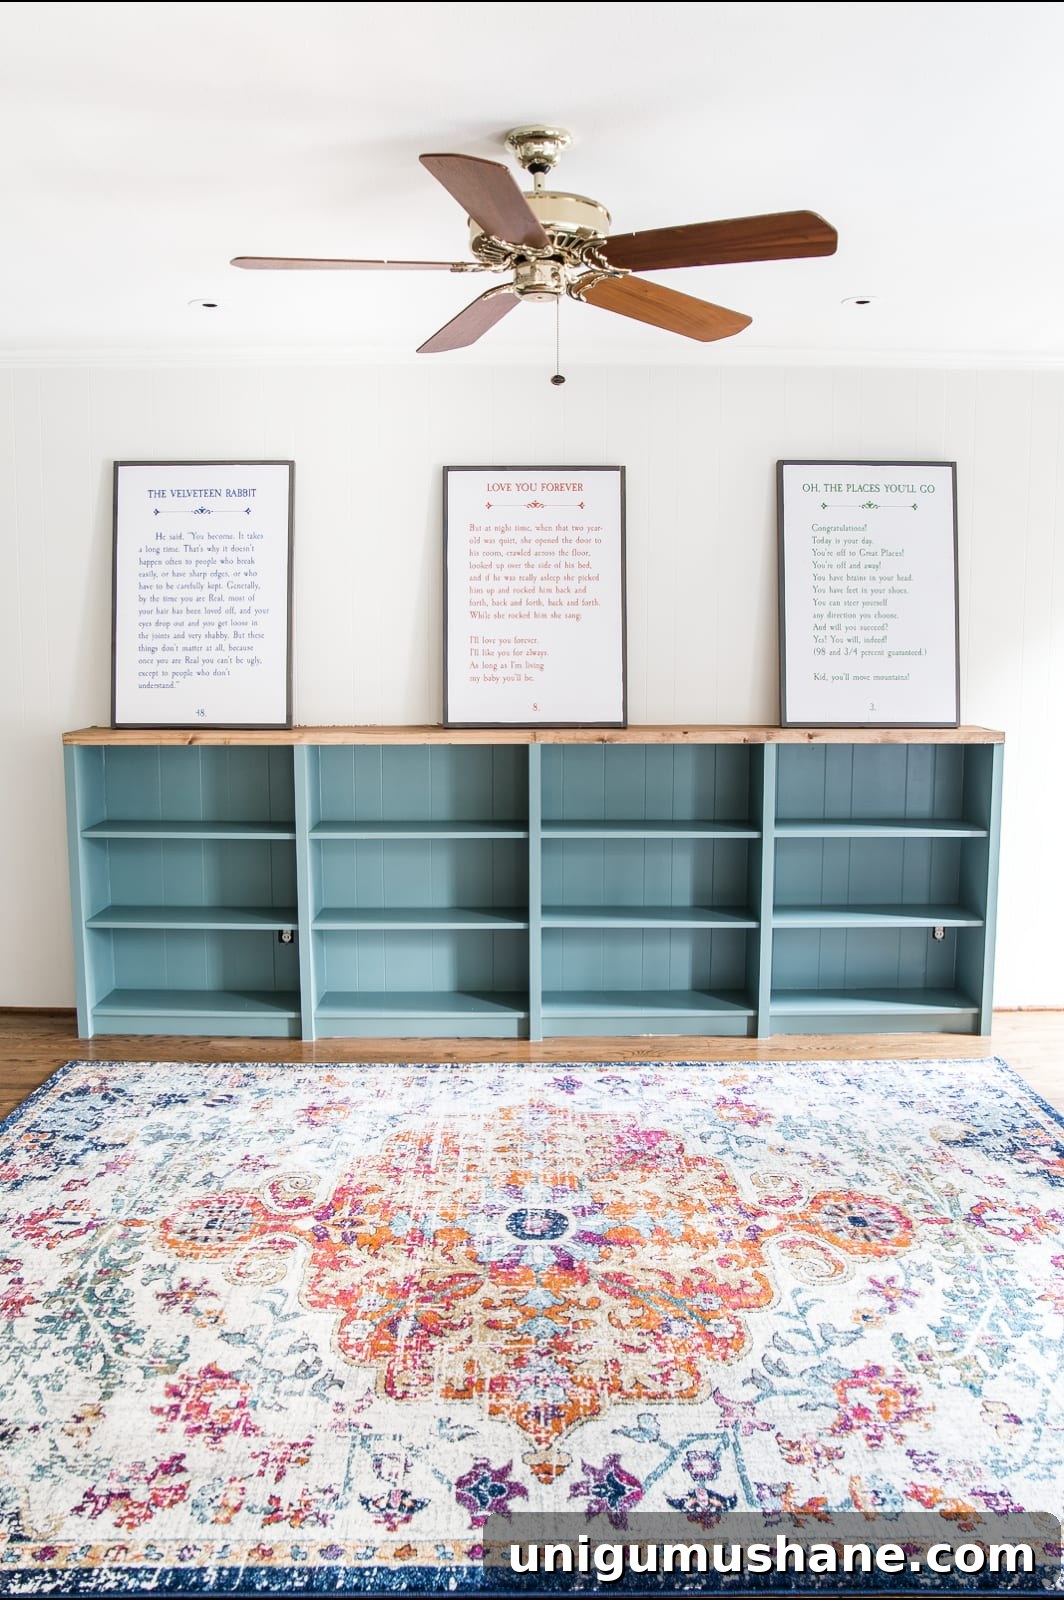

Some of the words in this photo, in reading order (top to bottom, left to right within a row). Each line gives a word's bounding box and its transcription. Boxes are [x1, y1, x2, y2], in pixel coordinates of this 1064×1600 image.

[487, 483, 512, 491] LOVE
[515, 483, 537, 491] YOU
[541, 483, 583, 491] FOREVER
[802, 484, 821, 493] OH,
[823, 484, 844, 492] THE
[846, 484, 881, 493] PLACES
[919, 484, 936, 493] GO
[148, 489, 167, 498] THE
[169, 489, 222, 498] VELVETEEN
[225, 489, 256, 498] RABBIT
[484, 524, 492, 532] at
[494, 523, 512, 534] night
[555, 523, 569, 532] that
[571, 524, 584, 532] two
[155, 532, 167, 540] He
[238, 531, 245, 540] It
[246, 531, 264, 540] takes
[468, 535, 481, 544] old
[534, 535, 559, 547] opened
[561, 535, 573, 544] the
[575, 535, 592, 544] door
[594, 536, 602, 544] to
[811, 536, 832, 547] Today
[844, 539, 859, 547] your
[144, 544, 161, 555] long
[206, 544, 220, 555] why
[222, 544, 228, 553] it
[558, 548, 569, 556] the
[836, 548, 846, 557] off
[848, 549, 857, 557] to
[859, 548, 879, 557] Great
[138, 556, 163, 568] happen
[164, 556, 183, 565] often
[184, 557, 193, 565] to
[194, 556, 217, 567] people
[219, 556, 234, 564] who
[236, 556, 255, 564] break
[469, 560, 493, 569] looked
[495, 563, 505, 572] up
[524, 560, 536, 569] the
[564, 560, 575, 569] his
[836, 560, 846, 569] off
[849, 560, 861, 569] and
[864, 560, 881, 572] away!
[172, 568, 186, 577] have
[189, 568, 207, 580] sharp
[243, 568, 258, 577] who
[469, 573, 482, 581] and
[519, 573, 537, 584] really
[578, 573, 600, 584] picked
[812, 573, 826, 581] You
[828, 573, 844, 581] have
[138, 581, 153, 590] have
[156, 582, 164, 590] to
[165, 581, 174, 589] be
[486, 588, 495, 596] up
[498, 585, 510, 594] and
[555, 585, 572, 594] back
[812, 585, 826, 594] You
[828, 585, 844, 594] have
[138, 593, 146, 605] by
[149, 593, 159, 602] the
[180, 596, 193, 604] you
[228, 594, 245, 602] most
[247, 593, 255, 601] of
[491, 598, 508, 606] back
[547, 598, 564, 606] back
[812, 598, 826, 606] You
[138, 608, 154, 617] your
[155, 606, 169, 614] hair
[171, 606, 184, 614] has
[204, 606, 222, 614] loved
[239, 605, 252, 614] and
[254, 608, 269, 617] your
[469, 610, 491, 619] While
[493, 610, 506, 619] she
[812, 613, 825, 621] any
[826, 610, 857, 619] direction
[859, 613, 872, 621] you
[154, 618, 172, 629] drop
[187, 618, 200, 626] and
[202, 621, 215, 629] you
[217, 619, 228, 629] get
[251, 618, 258, 627] in
[812, 622, 827, 631] And
[829, 622, 842, 631] will
[844, 625, 857, 634] you
[138, 630, 149, 639] the
[173, 630, 185, 639] and
[188, 633, 202, 642] very
[233, 630, 245, 639] But
[248, 630, 265, 639] these
[482, 635, 496, 644] love
[499, 638, 511, 647] you
[830, 635, 844, 643] You
[138, 643, 159, 654] things
[206, 643, 213, 652] at
[228, 642, 254, 651] because
[482, 648, 495, 656] like
[497, 651, 510, 659] you
[512, 648, 523, 656] for
[813, 647, 826, 656] (98
[828, 647, 841, 656] and
[843, 647, 858, 656] 3/4
[156, 658, 169, 667] you
[184, 655, 199, 664] Real
[202, 658, 214, 666] you
[469, 660, 479, 669] As
[482, 660, 498, 672] long
[161, 668, 169, 677] to
[171, 668, 193, 679] people
[196, 667, 210, 676] who
[470, 676, 481, 684] my
[483, 673, 500, 684] baby
